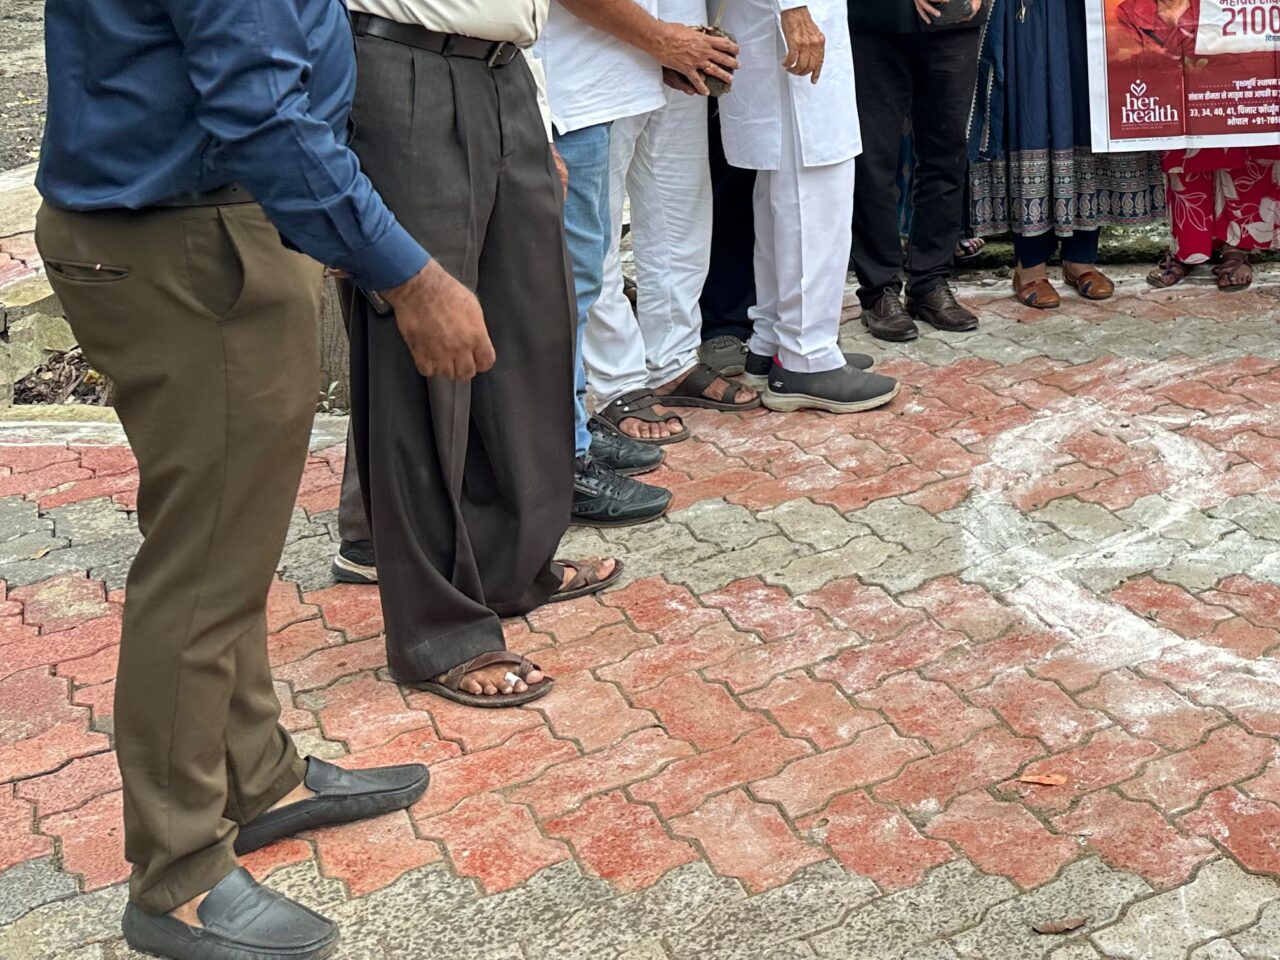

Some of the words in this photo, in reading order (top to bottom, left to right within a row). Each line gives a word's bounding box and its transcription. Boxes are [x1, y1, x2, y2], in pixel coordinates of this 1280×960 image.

[1125, 93, 1160, 110] her
[1121, 104, 1179, 123] health
[1189, 108, 1200, 117] 33,
[1201, 108, 1213, 117] 34,
[1226, 107, 1237, 115] 41,
[1227, 116, 1249, 125] भोपाल
